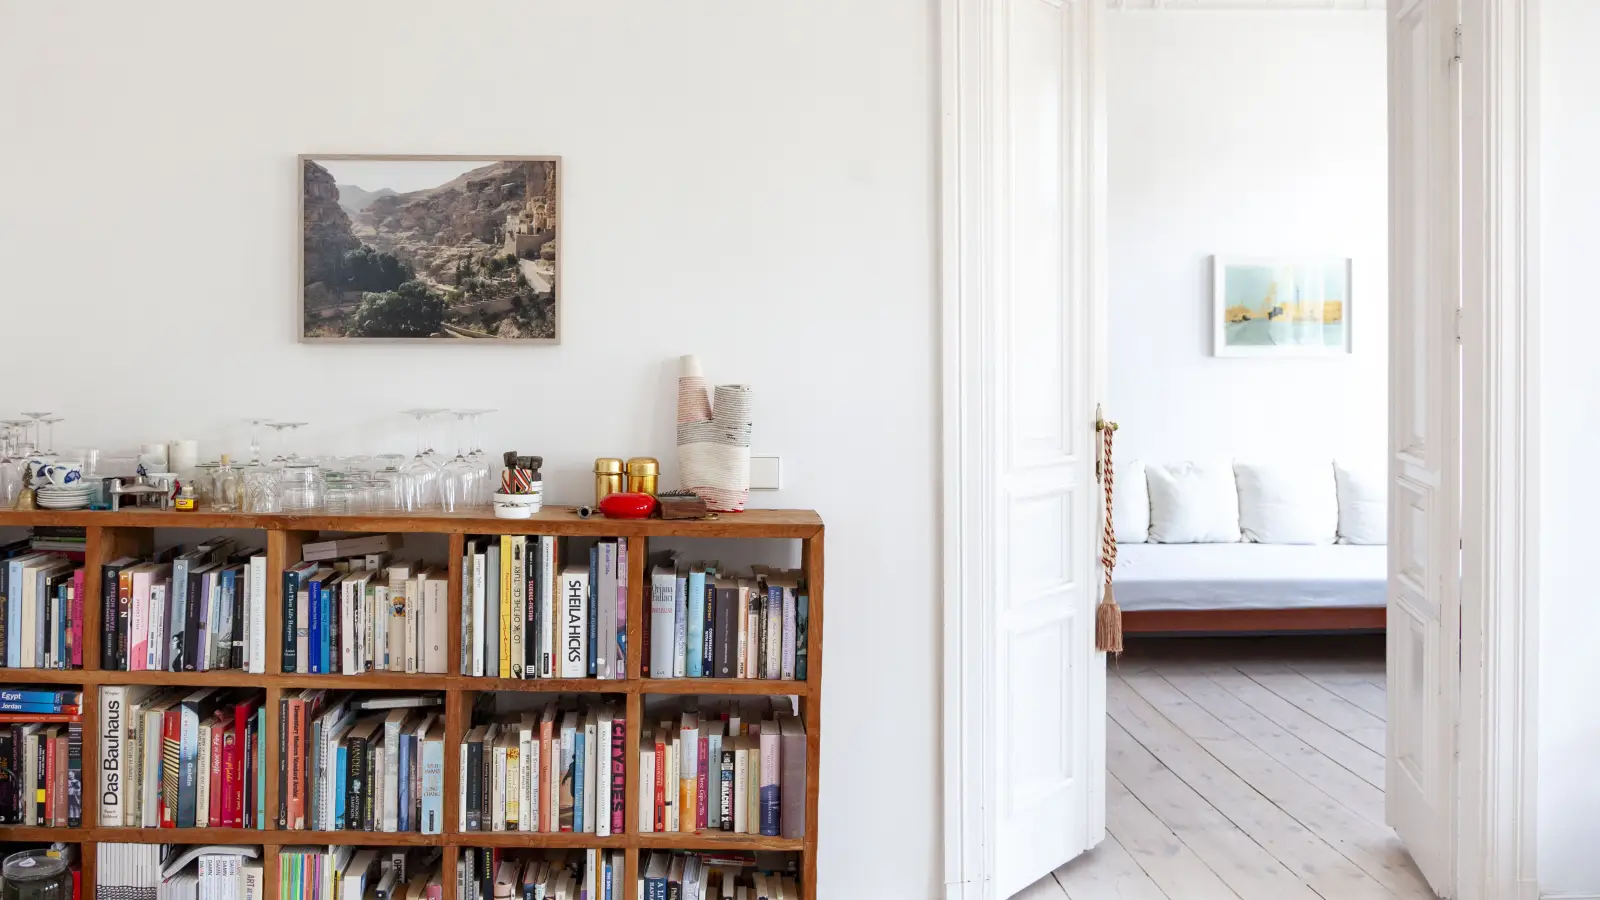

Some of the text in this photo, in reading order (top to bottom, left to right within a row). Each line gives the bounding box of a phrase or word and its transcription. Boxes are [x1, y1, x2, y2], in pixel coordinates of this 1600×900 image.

[569, 580, 581, 662] SHEILA HICKS
[2, 692, 21, 700] Egypt
[103, 700, 120, 805] Das Bauhaus
[351, 740, 360, 777] MANDELA
[612, 723, 625, 764] CITY
[612, 774, 625, 812] LIES
